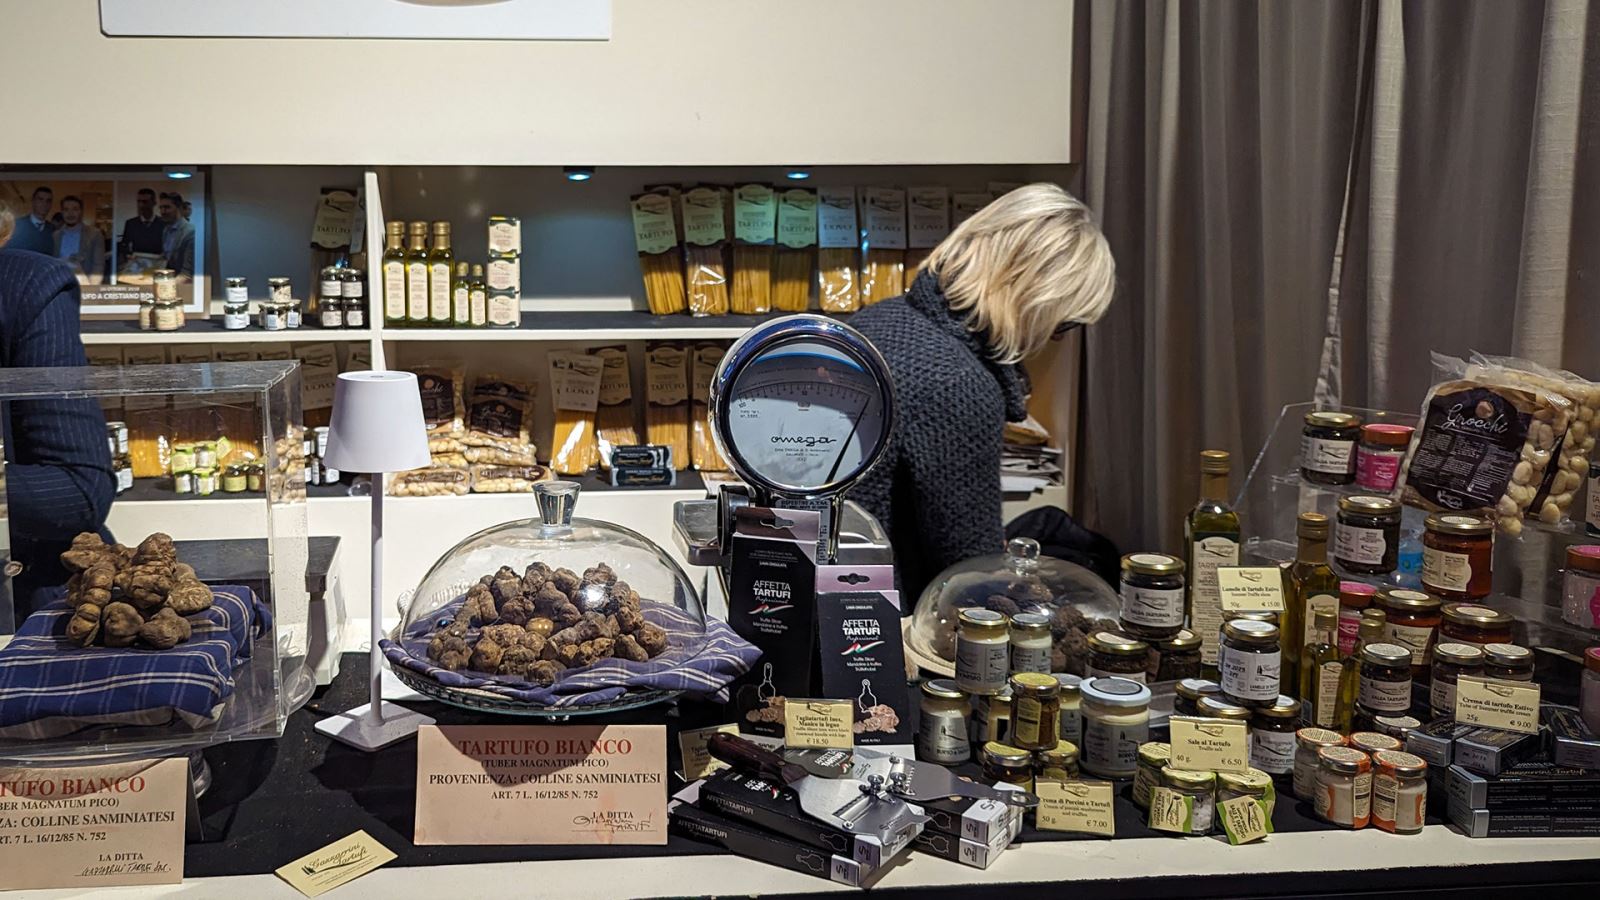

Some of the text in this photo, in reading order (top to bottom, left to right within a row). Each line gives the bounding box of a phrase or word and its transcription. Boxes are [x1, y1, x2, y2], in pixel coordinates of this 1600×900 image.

[1441, 404, 1508, 434] Gnocchi
[770, 436, 837, 446] omega
[754, 580, 791, 590] AFFETTA
[752, 588, 791, 599] TARTUFI
[842, 620, 880, 628] AFFETTA
[842, 627, 880, 636] TARTUFI
[1462, 697, 1483, 705] Crema
[1492, 702, 1514, 710] tartufo
[1514, 704, 1534, 712] Estivo
[1516, 720, 1532, 728] 9.00
[459, 738, 632, 756] TARTUFO BIANCO
[480, 758, 610, 768] (TUBER MAGNATUM PICO)
[429, 773, 661, 784] PROVENIENZA: COLLINE SANMINIATESI
[0, 776, 146, 798] TUFO BIANCO
[491, 790, 514, 799] ART.
[534, 790, 569, 799] 16/12/85
[571, 790, 582, 799] N.
[584, 790, 598, 799] 752
[21, 800, 86, 810] MAGNATUM
[90, 799, 120, 808] PICO)
[21, 814, 80, 828] COLLINE
[82, 812, 175, 826] SANMINIATESI
[607, 811, 634, 819] DITTA
[14, 836, 20, 844] 7
[24, 836, 34, 844] L.
[36, 833, 74, 843] 16/12/85
[78, 833, 88, 842] N.
[90, 832, 106, 841] 752
[114, 853, 144, 861] DITTA
